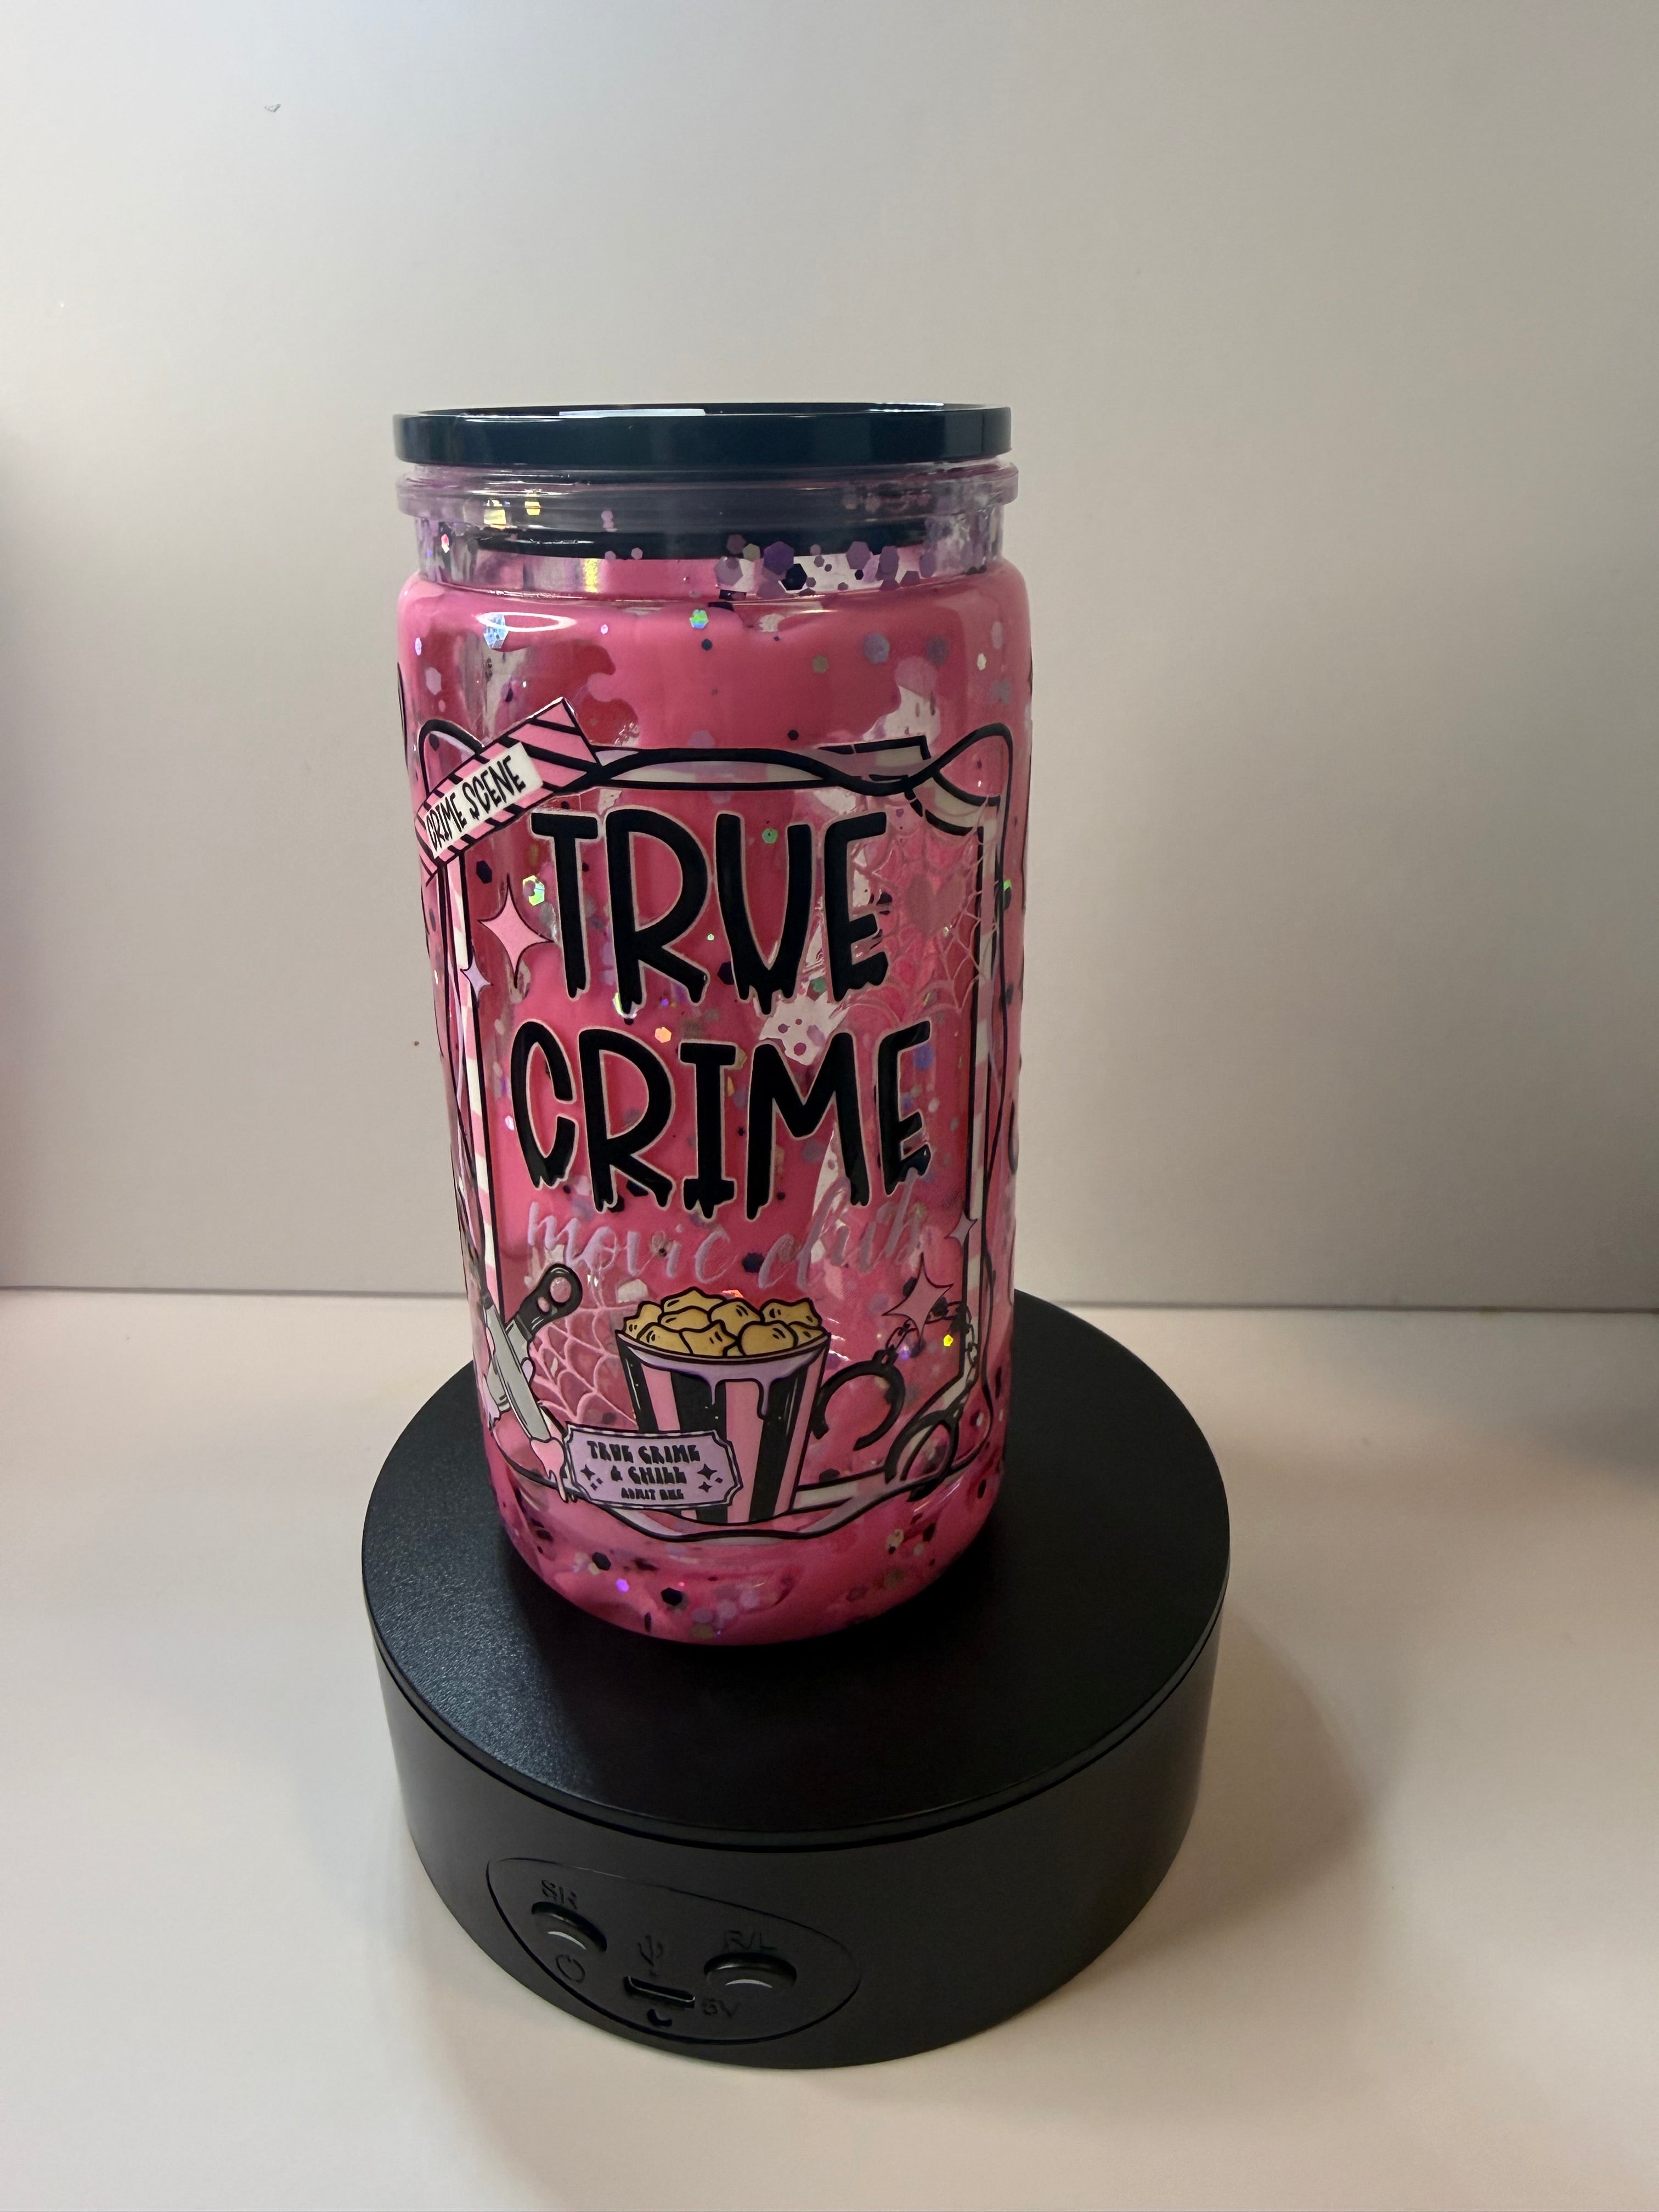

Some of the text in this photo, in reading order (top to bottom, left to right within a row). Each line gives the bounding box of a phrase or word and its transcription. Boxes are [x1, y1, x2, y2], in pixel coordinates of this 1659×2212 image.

[426, 755, 526, 851] CRIME SCENE
[530, 809, 889, 1015] TRUE
[510, 1020, 932, 1220] CRIME
[586, 1440, 701, 1465] TRUE CRIME
[628, 1466, 687, 1485] CHILL
[620, 1487, 656, 1500] ADMIT
